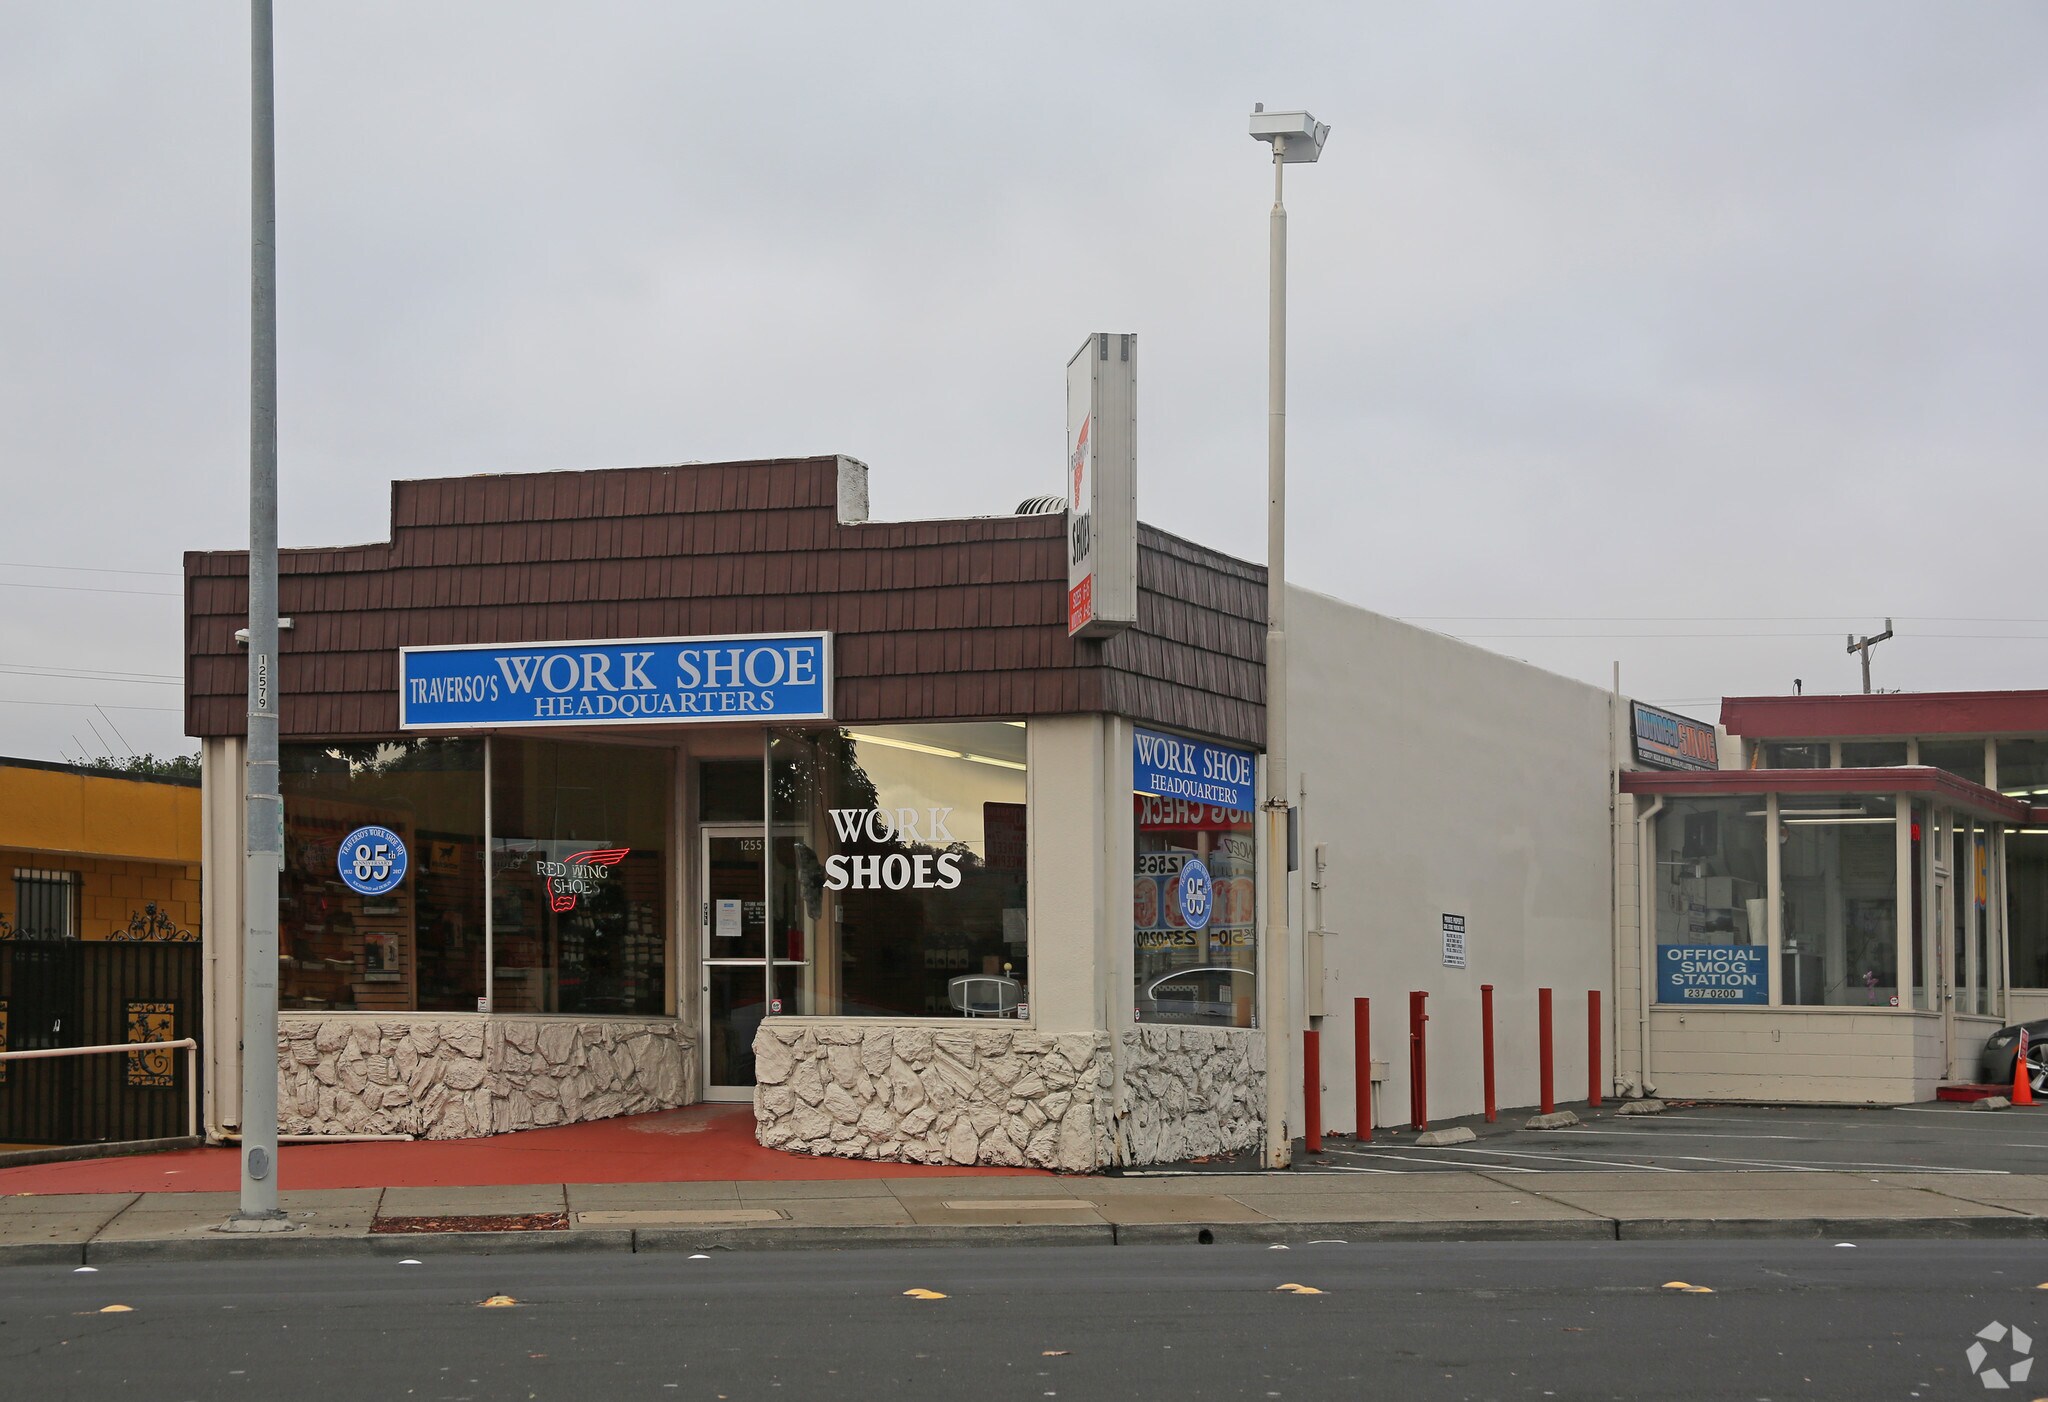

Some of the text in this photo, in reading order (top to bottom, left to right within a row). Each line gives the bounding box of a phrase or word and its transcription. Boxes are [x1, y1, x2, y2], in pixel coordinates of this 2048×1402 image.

[1072, 508, 1090, 566] SHOES
[259, 655, 267, 708] 12579
[410, 646, 816, 704] TRAVERSO'S WORK SHOE
[534, 689, 774, 717] HEADQUARTERS
[1135, 734, 1251, 786] WORK SHOE
[1150, 773, 1238, 804] HEADQUARTERS
[828, 807, 956, 843] WORK
[341, 829, 369, 855] TRAVERSO'S
[369, 828, 386, 838] WORK
[385, 833, 399, 847] SHOE
[395, 844, 404, 857] HQ
[740, 840, 766, 850] 1255
[536, 861, 608, 879] RED WING
[823, 853, 962, 890] SHOES
[554, 879, 600, 894] SHOES
[1667, 949, 1760, 961] OFFICIAL
[1681, 961, 1747, 973] SMOG
[1671, 973, 1757, 986] STATION
[1688, 989, 1736, 998] 237-0200
